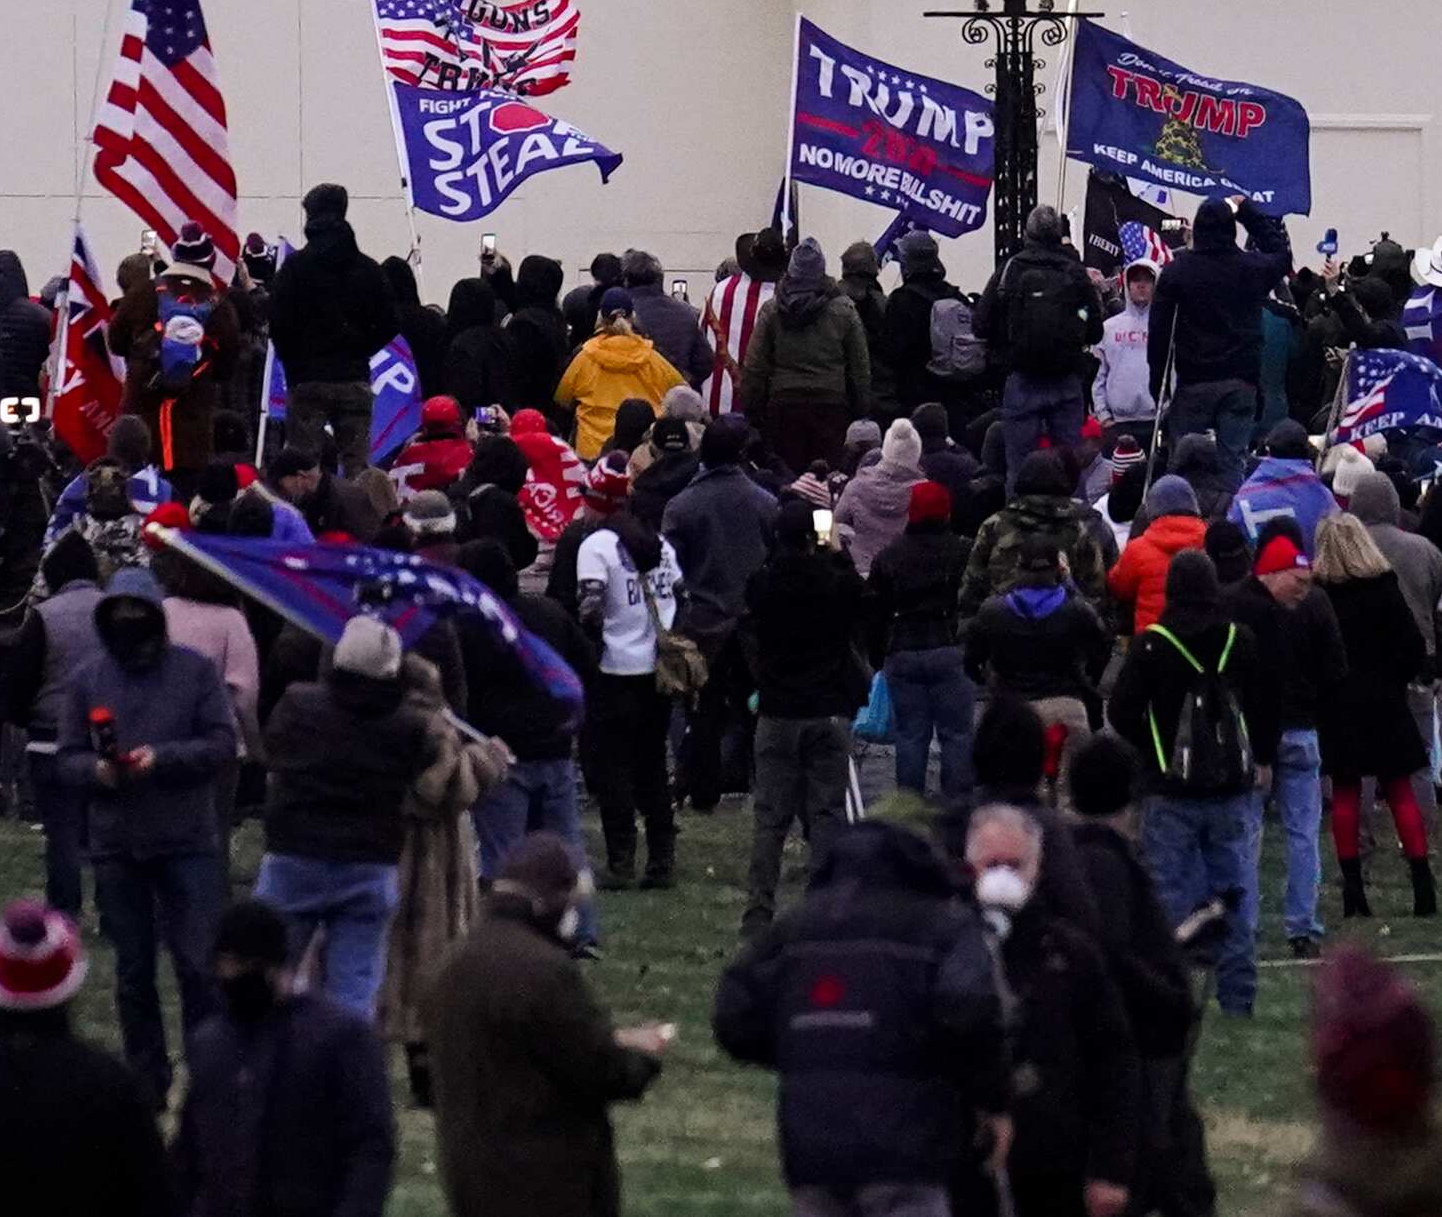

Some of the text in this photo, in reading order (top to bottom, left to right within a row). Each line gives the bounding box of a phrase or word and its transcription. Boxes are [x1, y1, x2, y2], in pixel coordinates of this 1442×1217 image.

[419, 96, 472, 114] FIGHT
[810, 43, 995, 156] TRUMP
[1107, 64, 1266, 138] TRUMP
[433, 133, 594, 216] STEAL
[1093, 143, 1138, 165] KEEP
[1141, 159, 1217, 188] AMERICA
[1351, 411, 1406, 440] KEEP
